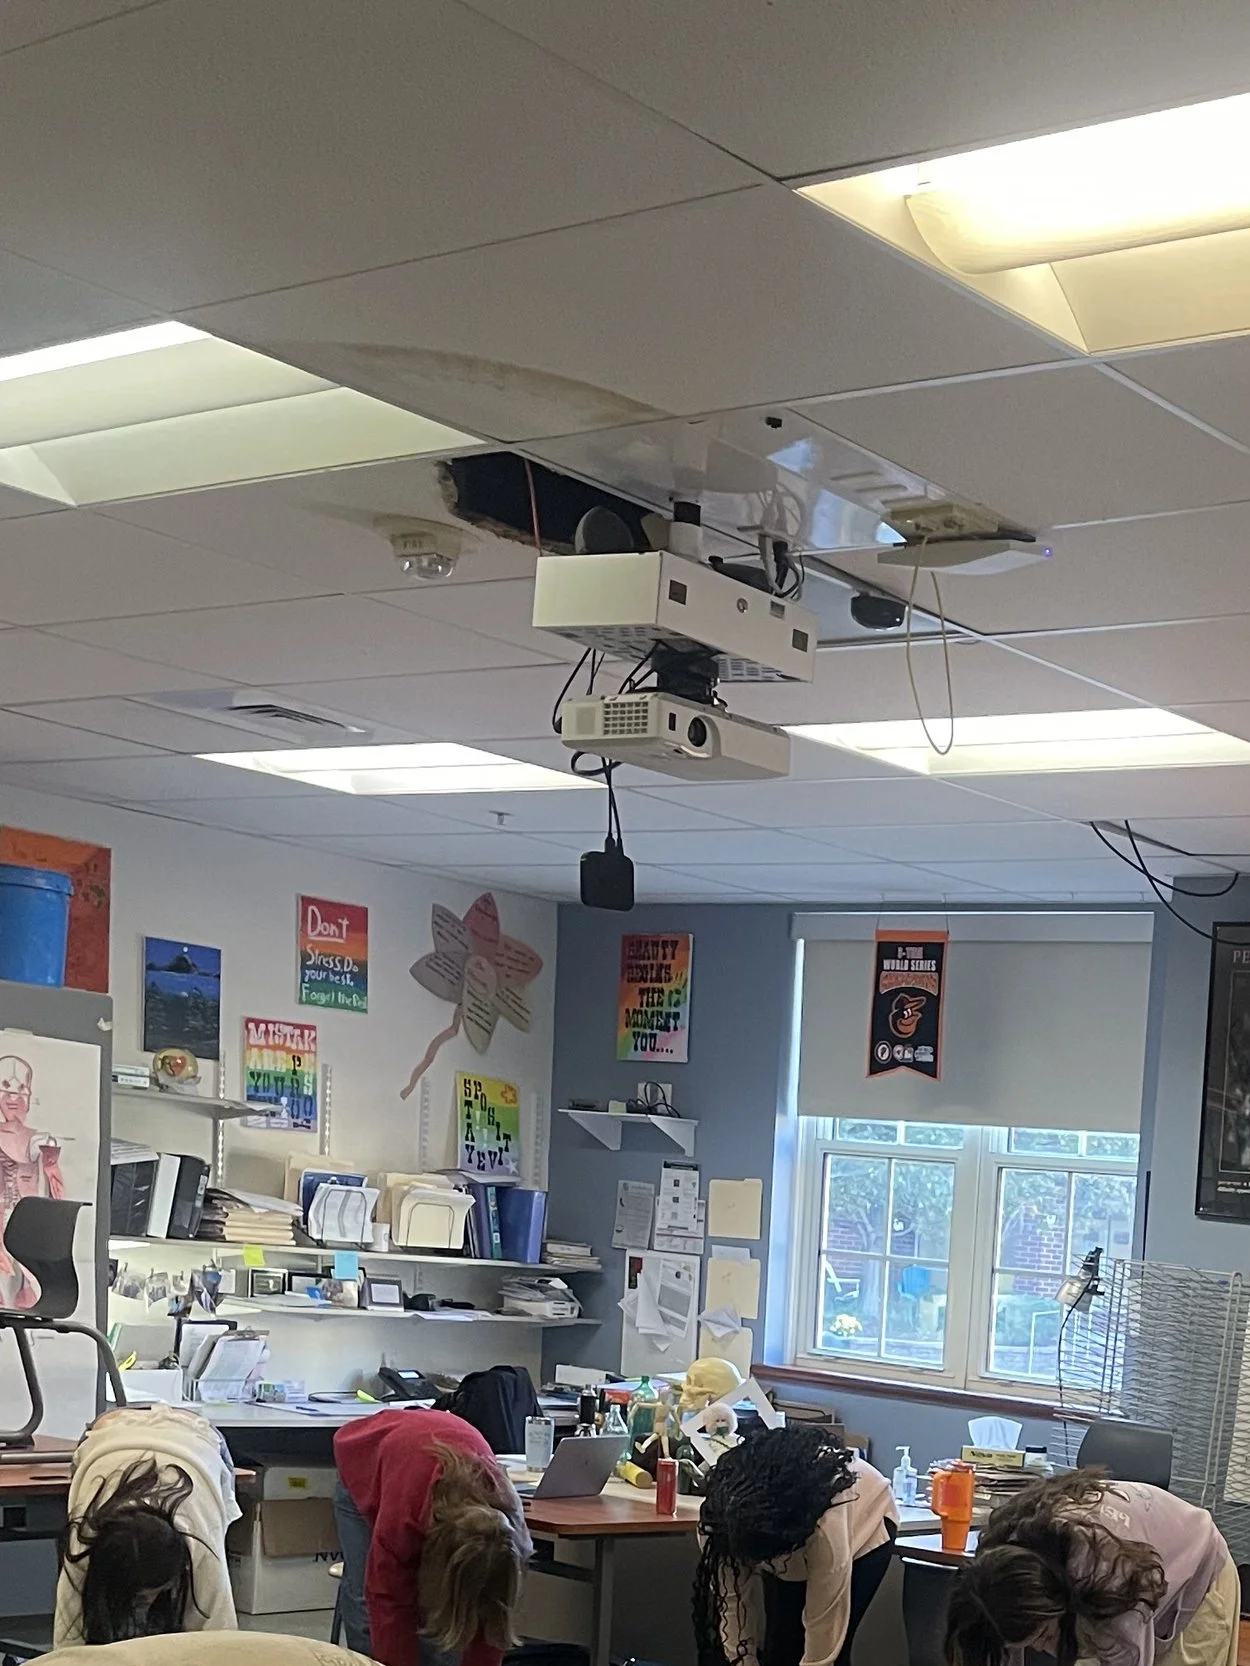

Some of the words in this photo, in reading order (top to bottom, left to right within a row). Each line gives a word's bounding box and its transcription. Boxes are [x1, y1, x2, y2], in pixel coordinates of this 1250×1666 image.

[911, 960, 936, 971] SERIES
[304, 969, 327, 982] your
[638, 985, 665, 1009] THE
